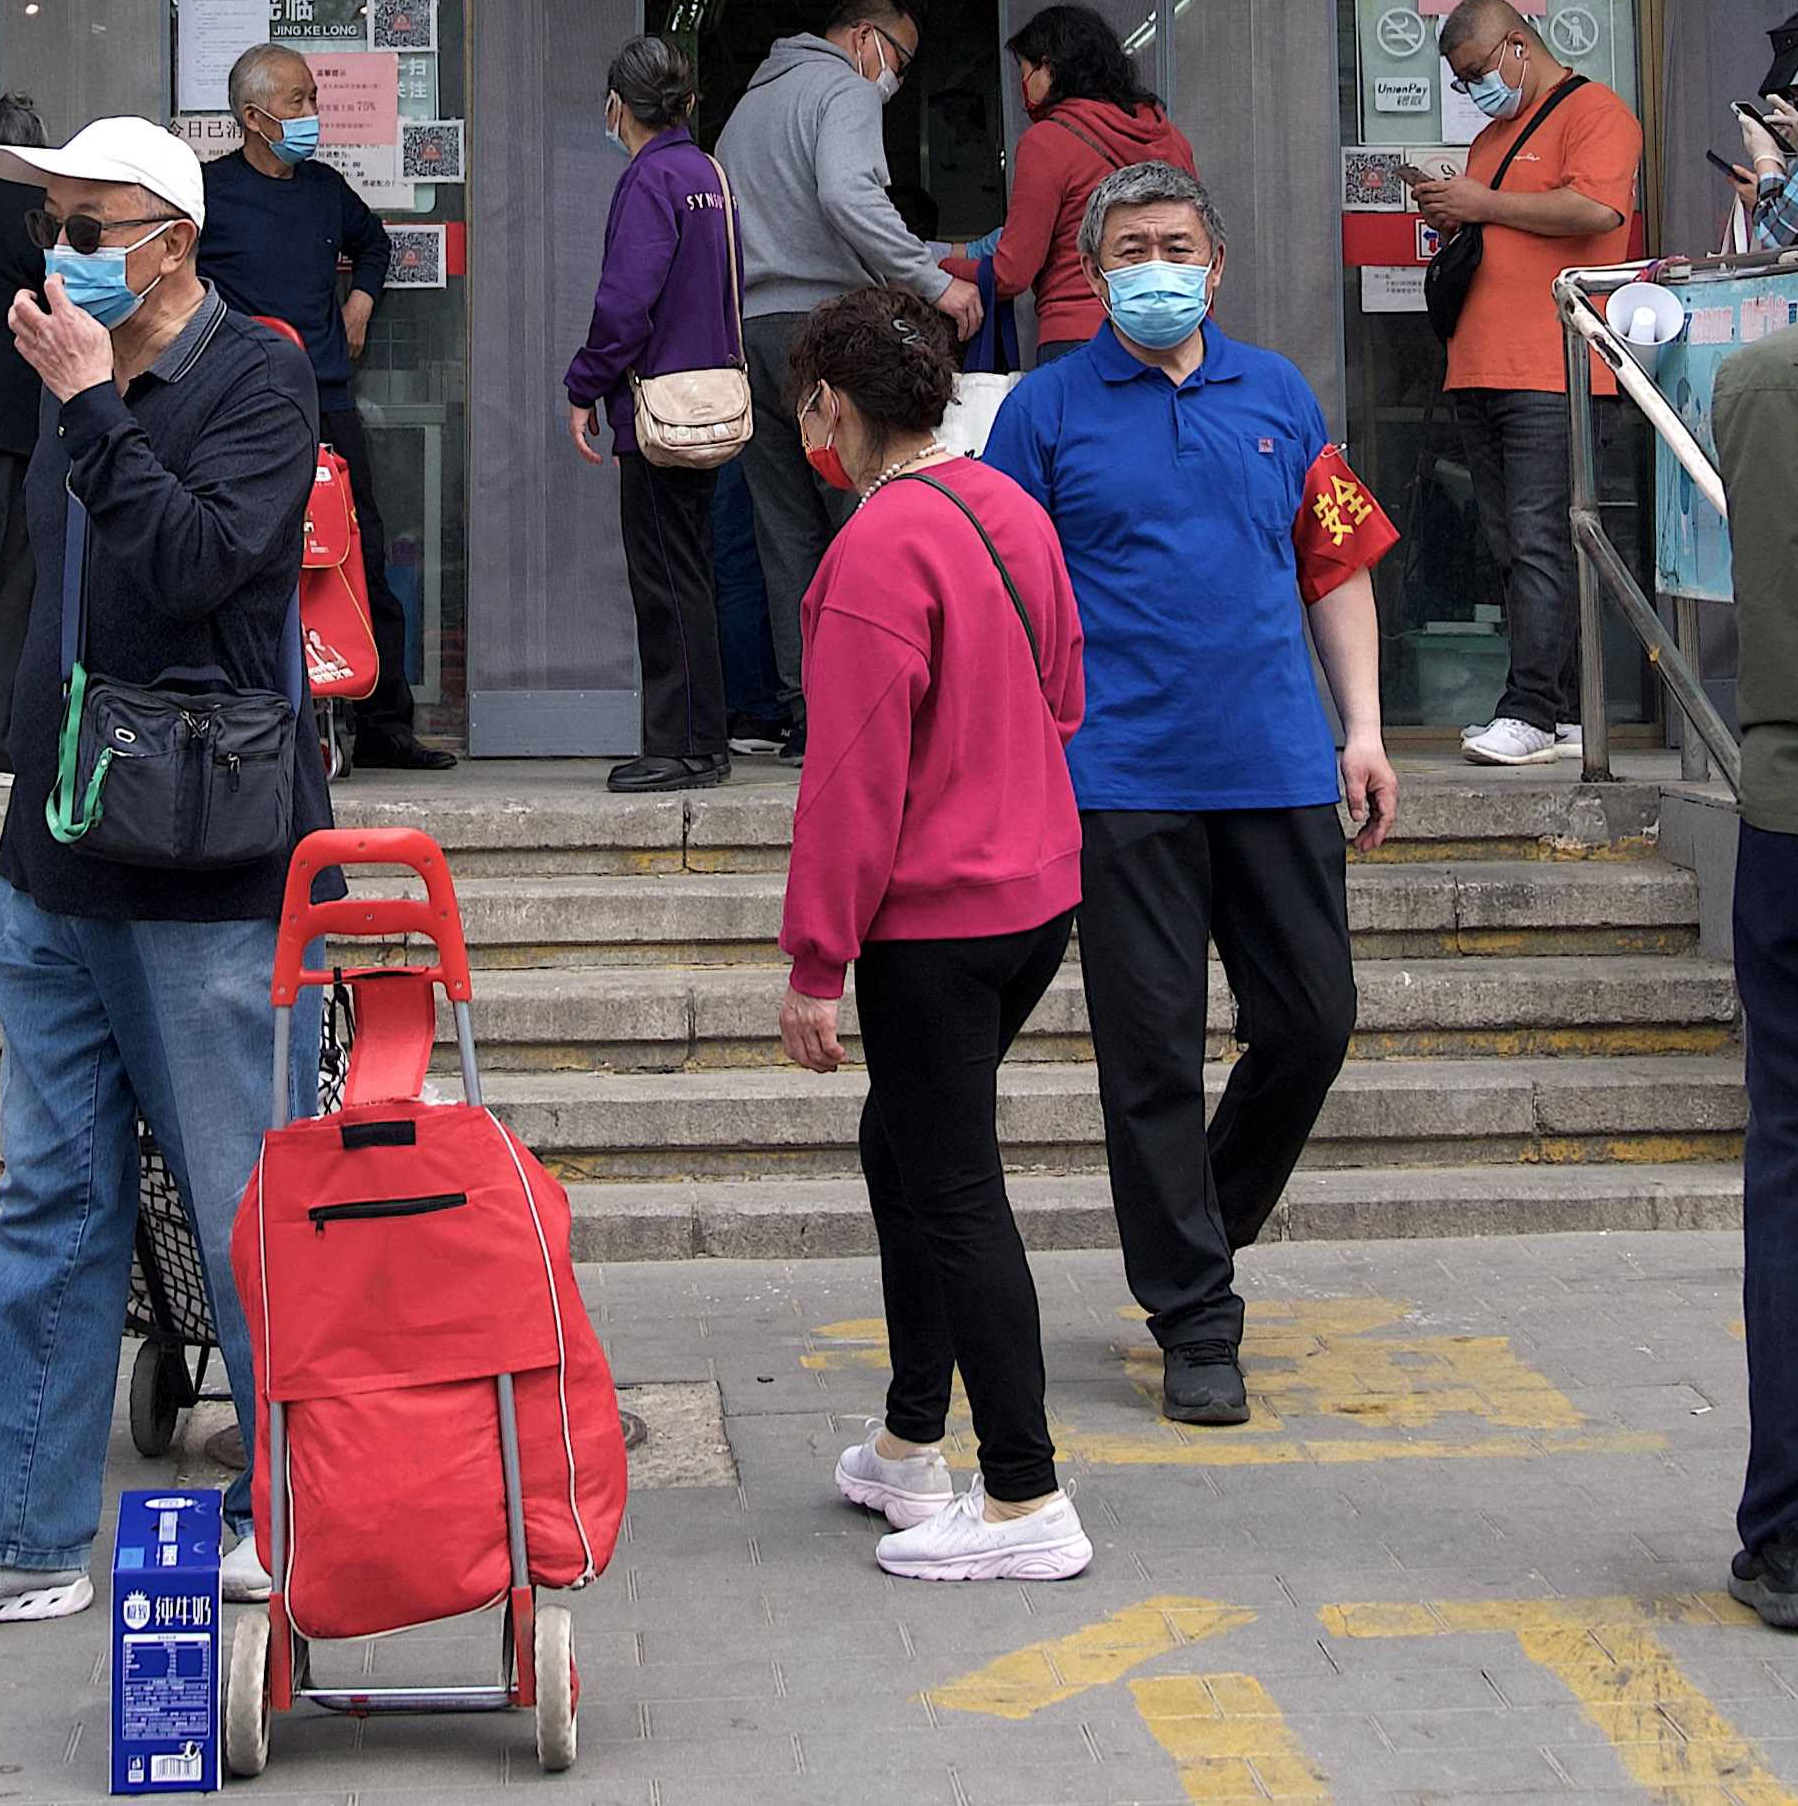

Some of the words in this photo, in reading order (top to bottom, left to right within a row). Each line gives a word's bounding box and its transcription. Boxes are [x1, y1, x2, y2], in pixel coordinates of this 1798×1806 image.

[273, 25, 301, 36] JING
[304, 25, 321, 36] KE
[323, 25, 357, 36] LONG
[1378, 83, 1428, 98] UnionPay
[1312, 474, 1373, 547] 安全
[154, 1595, 212, 1627] 纯牛奶
